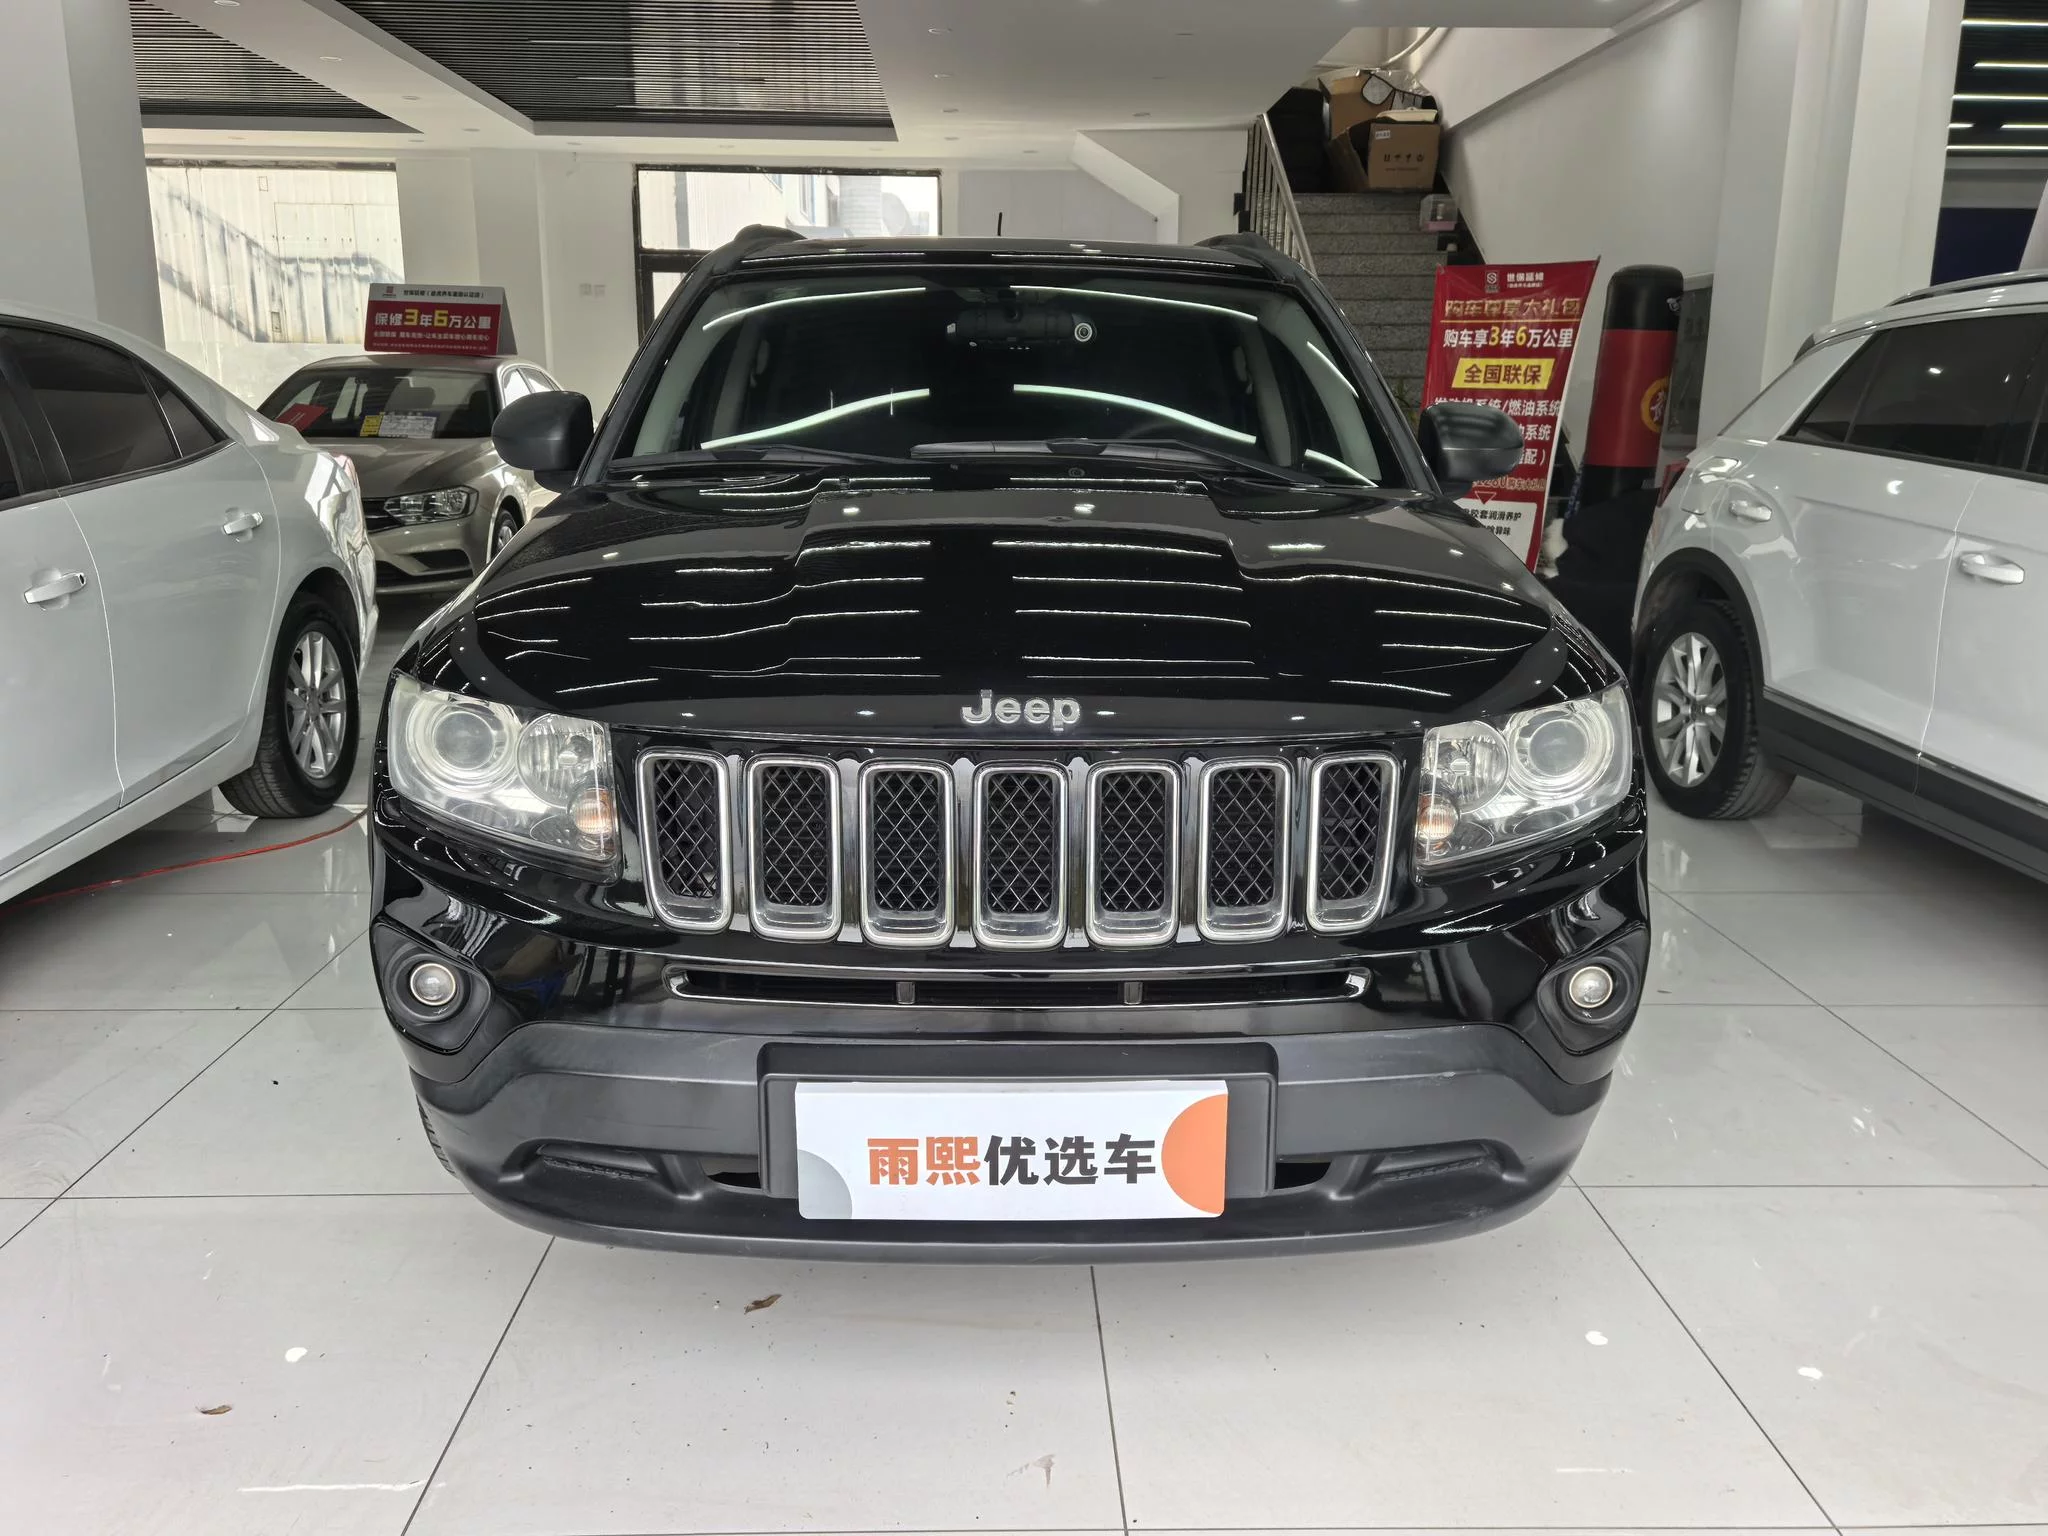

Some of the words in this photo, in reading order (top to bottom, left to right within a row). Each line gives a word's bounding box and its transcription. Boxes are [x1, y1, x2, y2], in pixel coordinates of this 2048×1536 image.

[375, 309, 491, 329] 保修3年6万公里
[1443, 326, 1573, 348] 购车享3年6万公里
[1464, 364, 1541, 385] 全国联保
[961, 689, 1081, 731] Jeep
[867, 1133, 1156, 1186] 雨熙优选车
